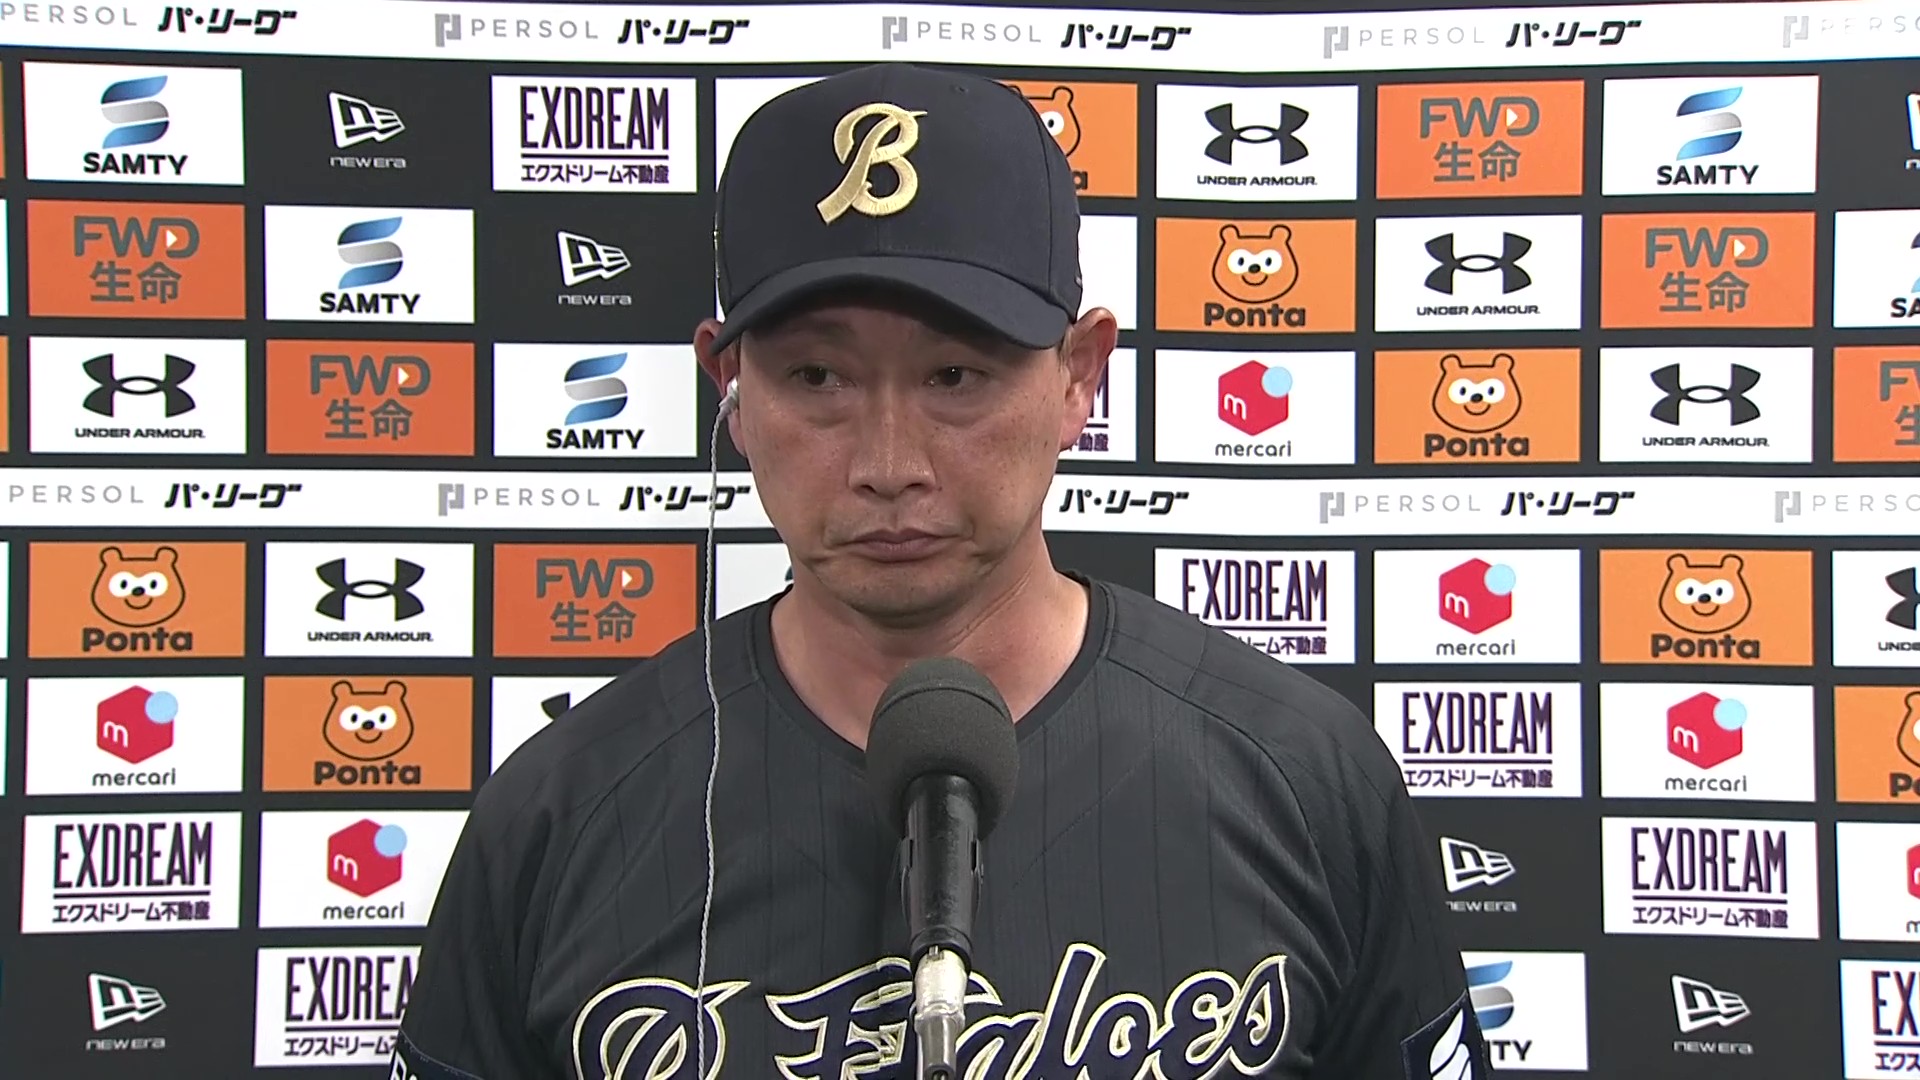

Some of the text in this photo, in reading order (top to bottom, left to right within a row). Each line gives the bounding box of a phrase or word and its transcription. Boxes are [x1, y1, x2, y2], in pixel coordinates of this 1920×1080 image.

[0, 2, 137, 26] PERSOL
[471, 19, 598, 39] PERSOL
[918, 21, 1041, 42] PERSOL
[1360, 27, 1484, 46] PERSOL
[520, 86, 669, 150] EXDREAM
[1420, 96, 1540, 138] FWD
[83, 152, 188, 175] SAMTY
[817, 103, 927, 223] B
[1434, 140, 1521, 182] 生命
[1197, 176, 1247, 185] UNDER
[1657, 165, 1759, 185] SAMTY
[74, 216, 200, 259] FWD
[1646, 227, 1769, 268] FWD
[90, 260, 182, 304] 生命
[1660, 271, 1749, 313] 生命
[320, 292, 420, 314] SAMTY
[1204, 302, 1306, 327] Ponta
[1417, 306, 1469, 316] UNDER
[310, 354, 431, 396] FWD
[325, 398, 413, 440] 生命
[1895, 404, 1920, 445] 生
[75, 428, 130, 438] UNDER
[547, 428, 644, 449] SAMTY
[1424, 432, 1529, 458] Ponta
[1642, 437, 1696, 446] UNDER
[1215, 441, 1291, 457] mercari
[9, 485, 143, 503] PERSOL
[475, 488, 600, 506] PERSOL
[1355, 495, 1480, 512] PERSOL
[1813, 494, 1920, 512] PERSO
[537, 558, 654, 599] FWD
[1182, 558, 1327, 621] EXDREAM
[551, 601, 637, 643] 生命
[82, 626, 193, 652] Ponta
[307, 632, 361, 641] UNDER
[1436, 639, 1515, 655] mercari
[1651, 634, 1760, 659] Ponta
[1878, 642, 1920, 651] UND
[1403, 692, 1552, 754] EXDREAM
[92, 768, 175, 786] mercari
[314, 760, 421, 785] Ponta
[1665, 775, 1747, 792] mercari
[53, 822, 212, 889] EXDREAM
[1631, 827, 1787, 894] EXDREAM
[323, 902, 404, 919] mercari
[285, 956, 413, 1020] EXDREA
[285, 1036, 396, 1056] エクスドリーム
